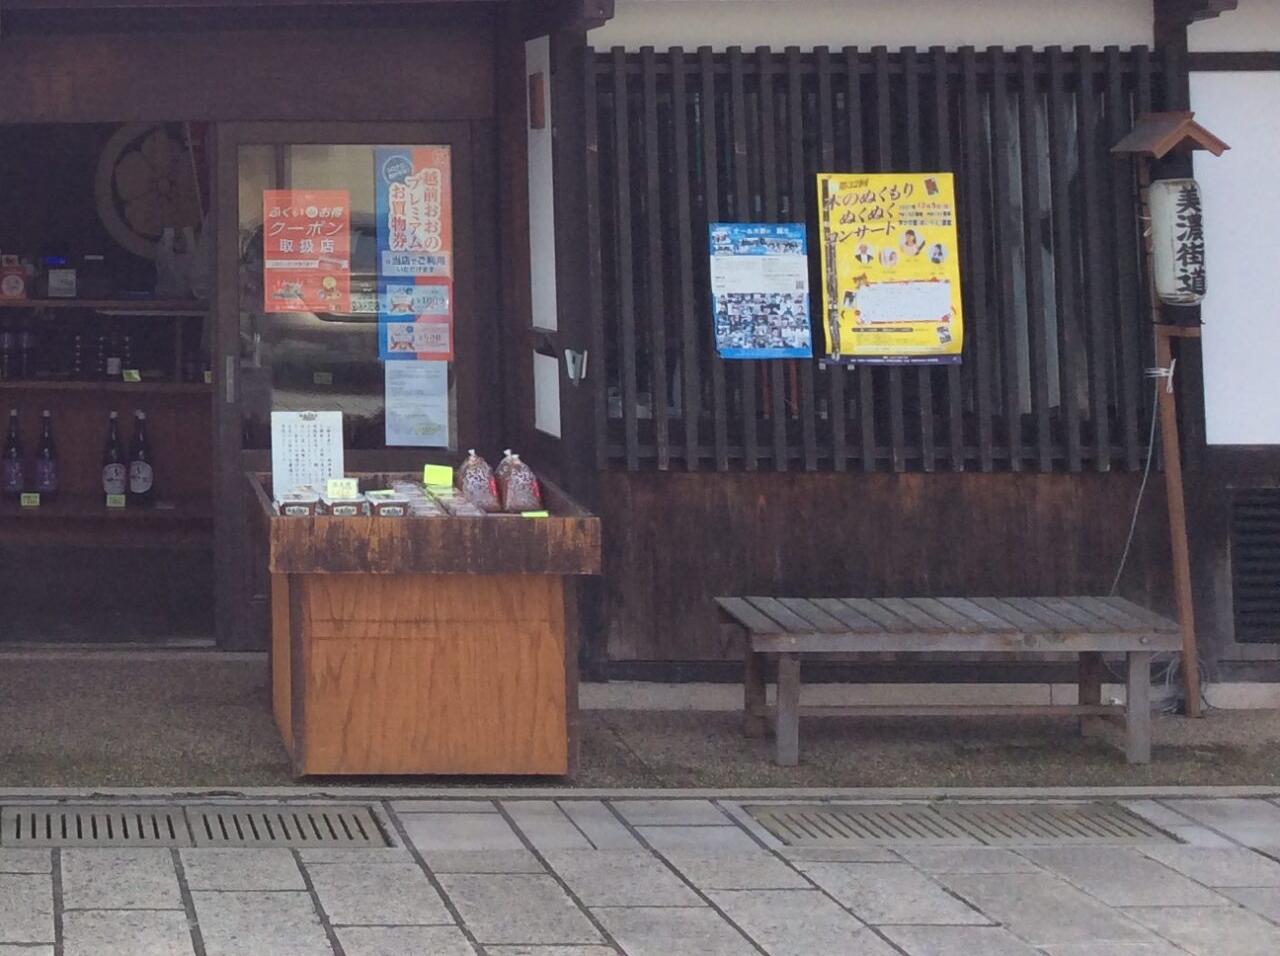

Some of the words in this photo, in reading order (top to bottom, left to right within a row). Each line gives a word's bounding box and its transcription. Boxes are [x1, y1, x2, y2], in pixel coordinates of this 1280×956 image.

[824, 182, 913, 210] 木のぬくもり
[407, 175, 422, 250] プレミアム
[839, 202, 895, 224] ぬくぬく
[825, 221, 895, 243] コンサート
[1176, 184, 1206, 296] 美濃街道
[279, 239, 335, 253] 取扱店
